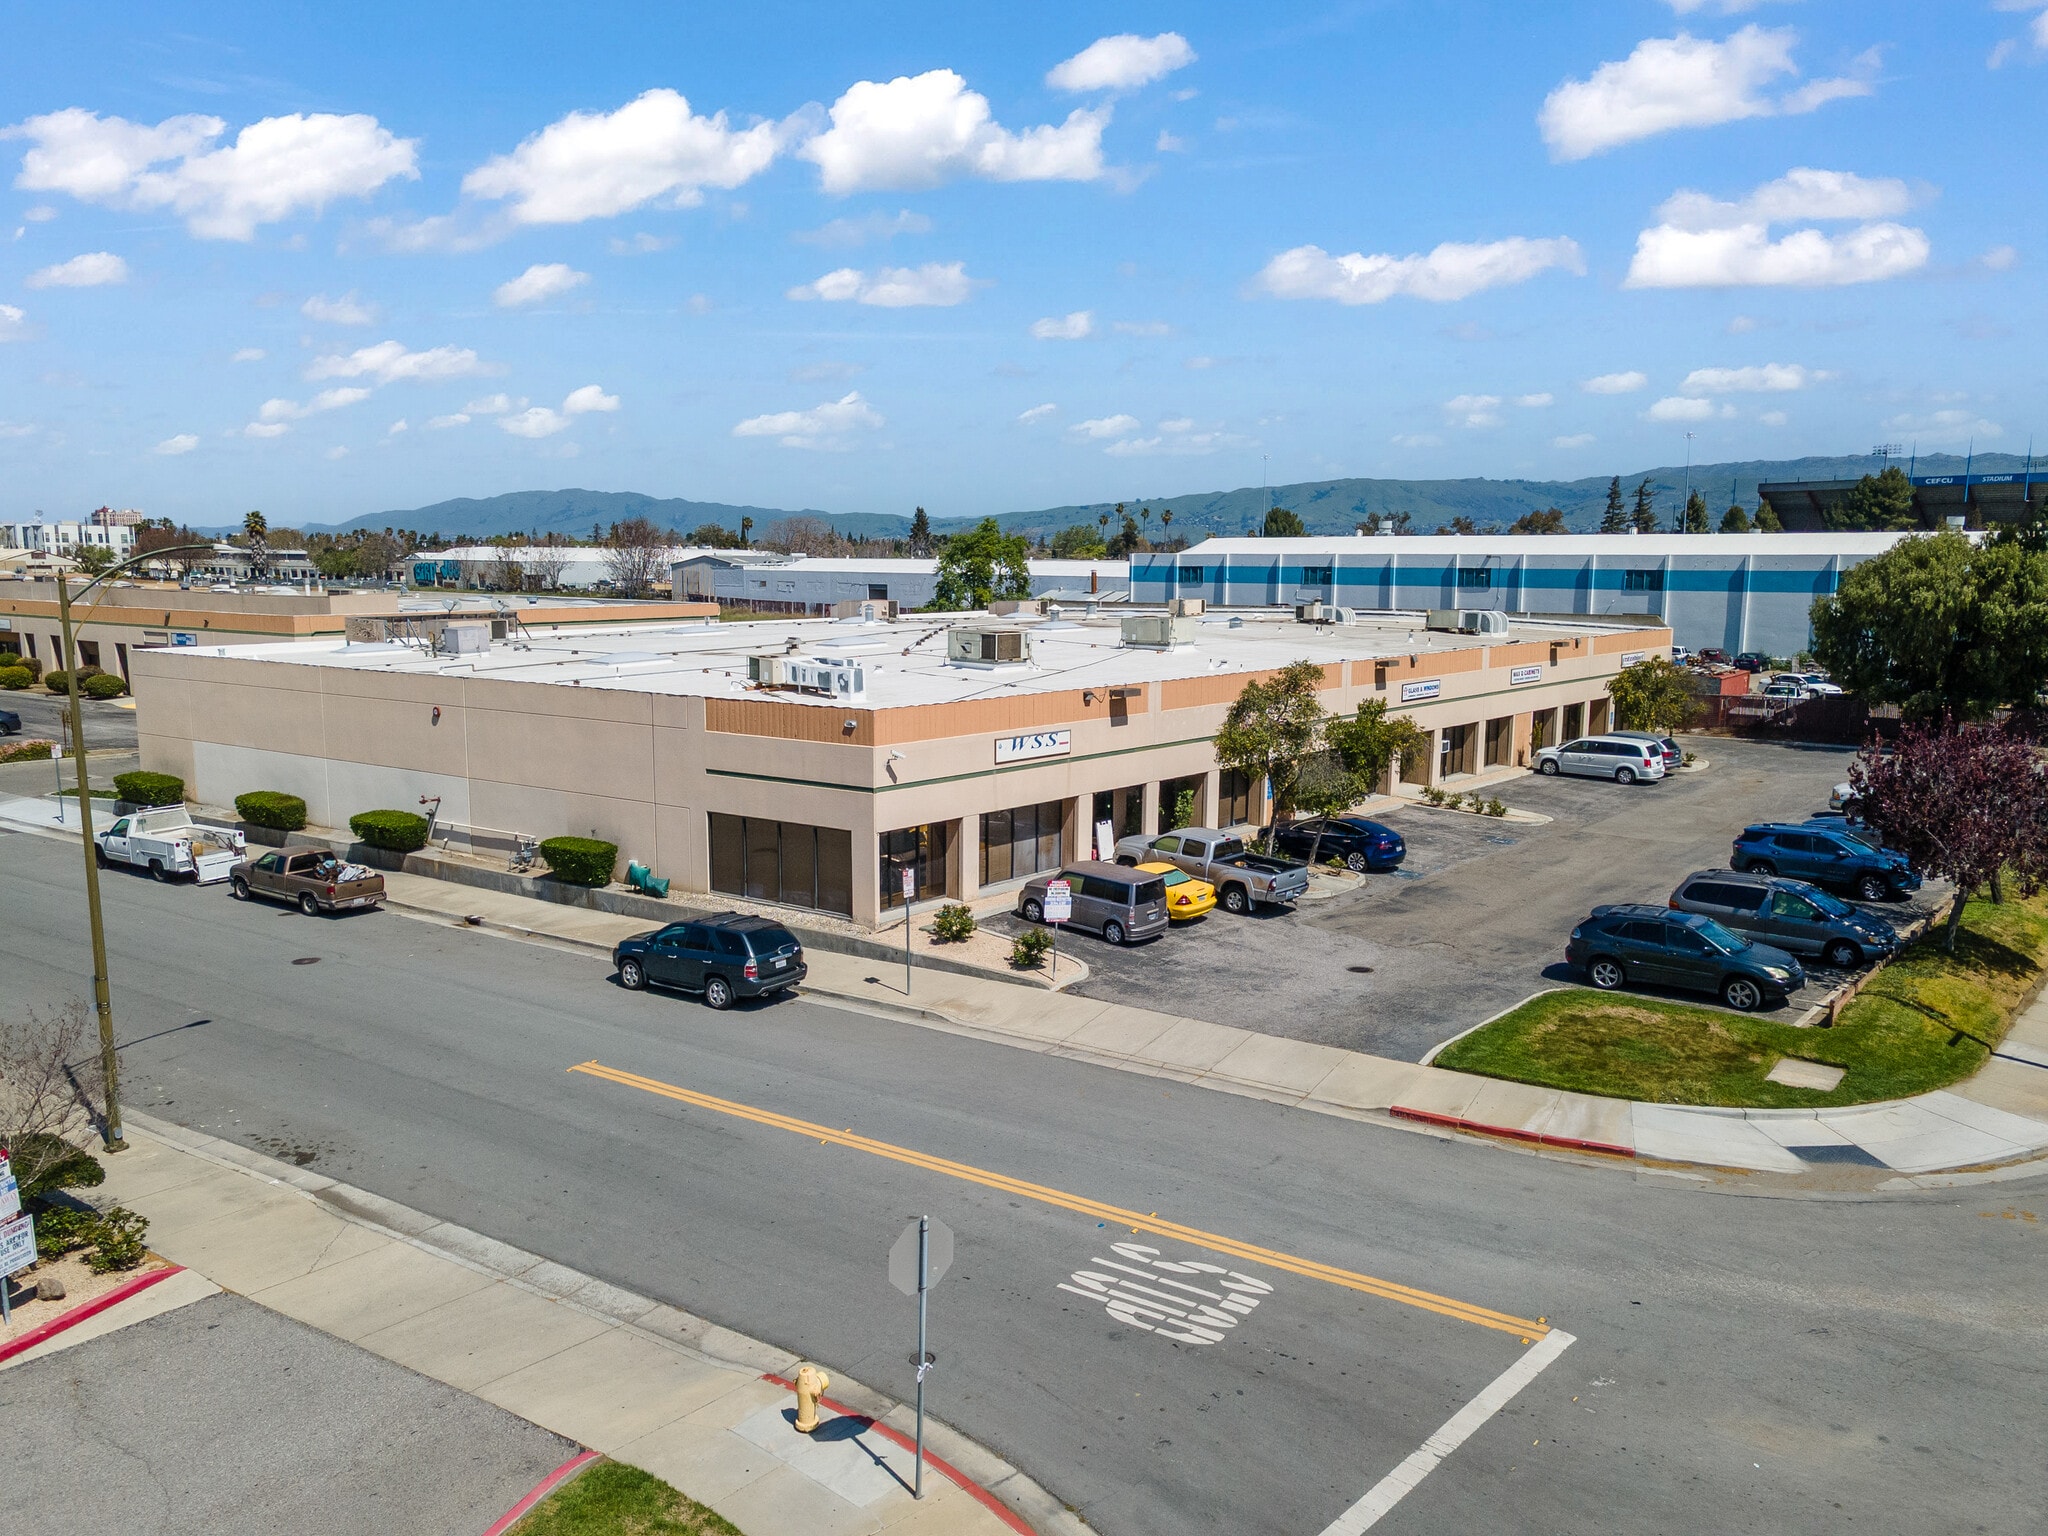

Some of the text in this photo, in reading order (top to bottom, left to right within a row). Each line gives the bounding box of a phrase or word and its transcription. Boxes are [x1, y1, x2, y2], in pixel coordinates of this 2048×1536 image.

[1925, 475, 2013, 485] CEFCU STADIUM
[1011, 732, 1058, 751] WSS
[12, 1240, 25, 1250] ONLY
[1056, 1242, 1274, 1345] STOP
